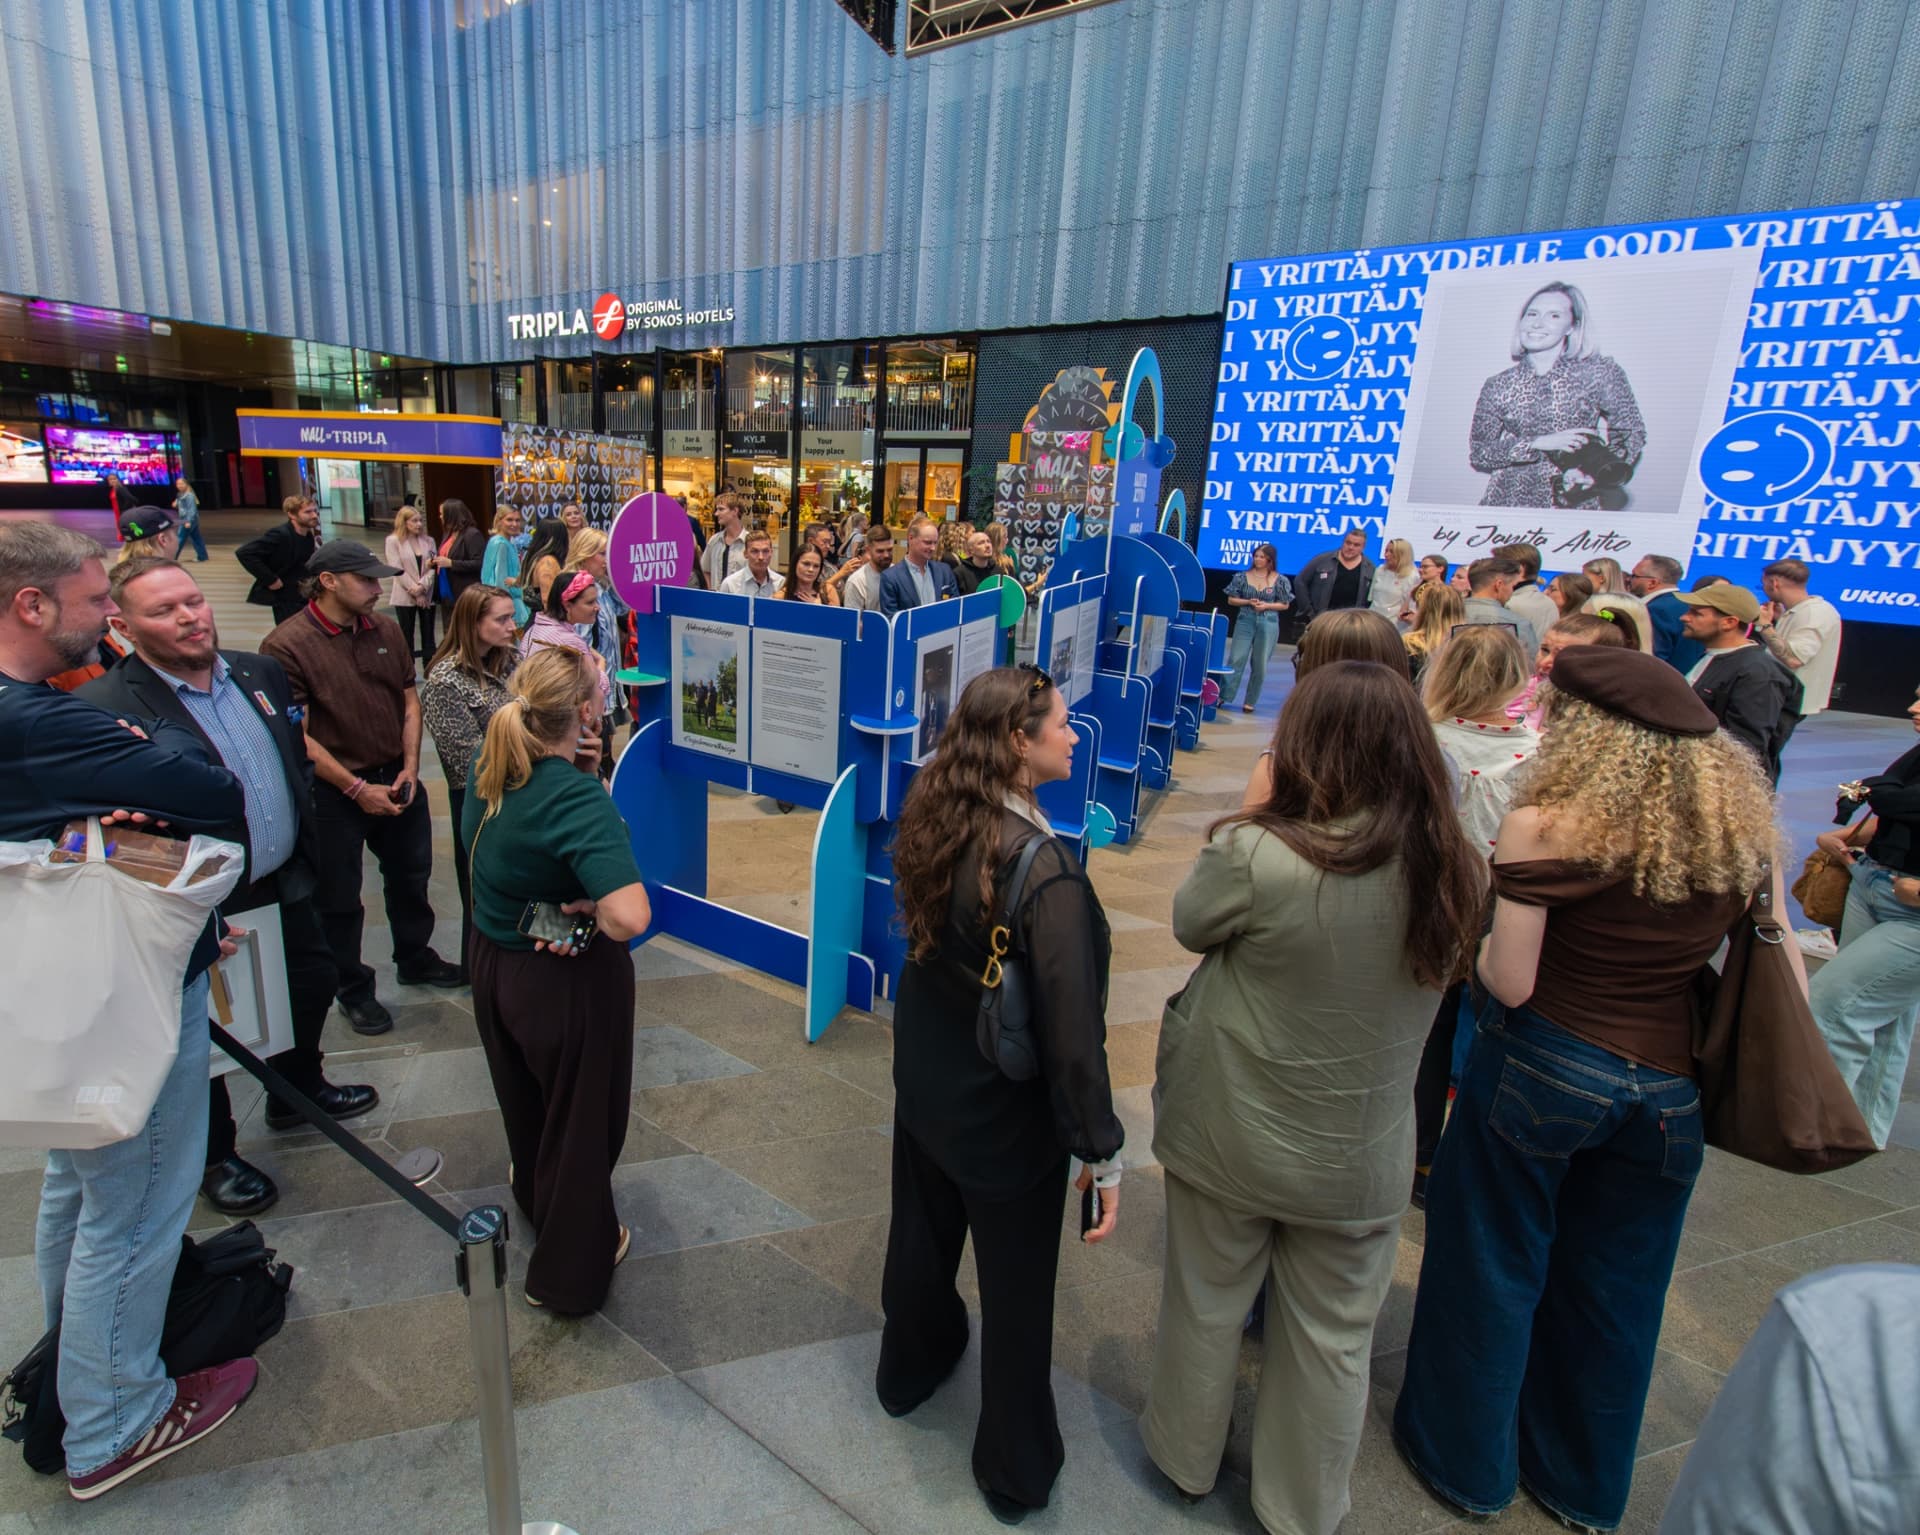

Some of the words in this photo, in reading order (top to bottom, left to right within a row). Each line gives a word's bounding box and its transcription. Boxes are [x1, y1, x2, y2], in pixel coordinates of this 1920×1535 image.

[1258, 239, 1563, 288] YRITTÄJYYDELLE
[1584, 227, 1699, 260] OODI
[627, 299, 682, 316] ORIGINAL
[1226, 299, 1257, 321] DI
[508, 309, 589, 340] TRIPLA
[627, 318, 641, 331] BY
[644, 313, 683, 329] SOKOS
[686, 308, 735, 325] HOTELS
[1218, 361, 1249, 382] DI
[331, 430, 387, 445] TRIPLA
[1211, 422, 1241, 442] DI
[805, 448, 825, 456] happy
[826, 447, 845, 456] place
[1203, 481, 1234, 501] DI
[1220, 538, 1270, 553] JANIT
[1433, 526, 1461, 551] by
[1466, 525, 1553, 548] Janita
[1552, 529, 1632, 554] Autio
[629, 541, 679, 564] JANITA
[632, 560, 677, 583] AUTIO
